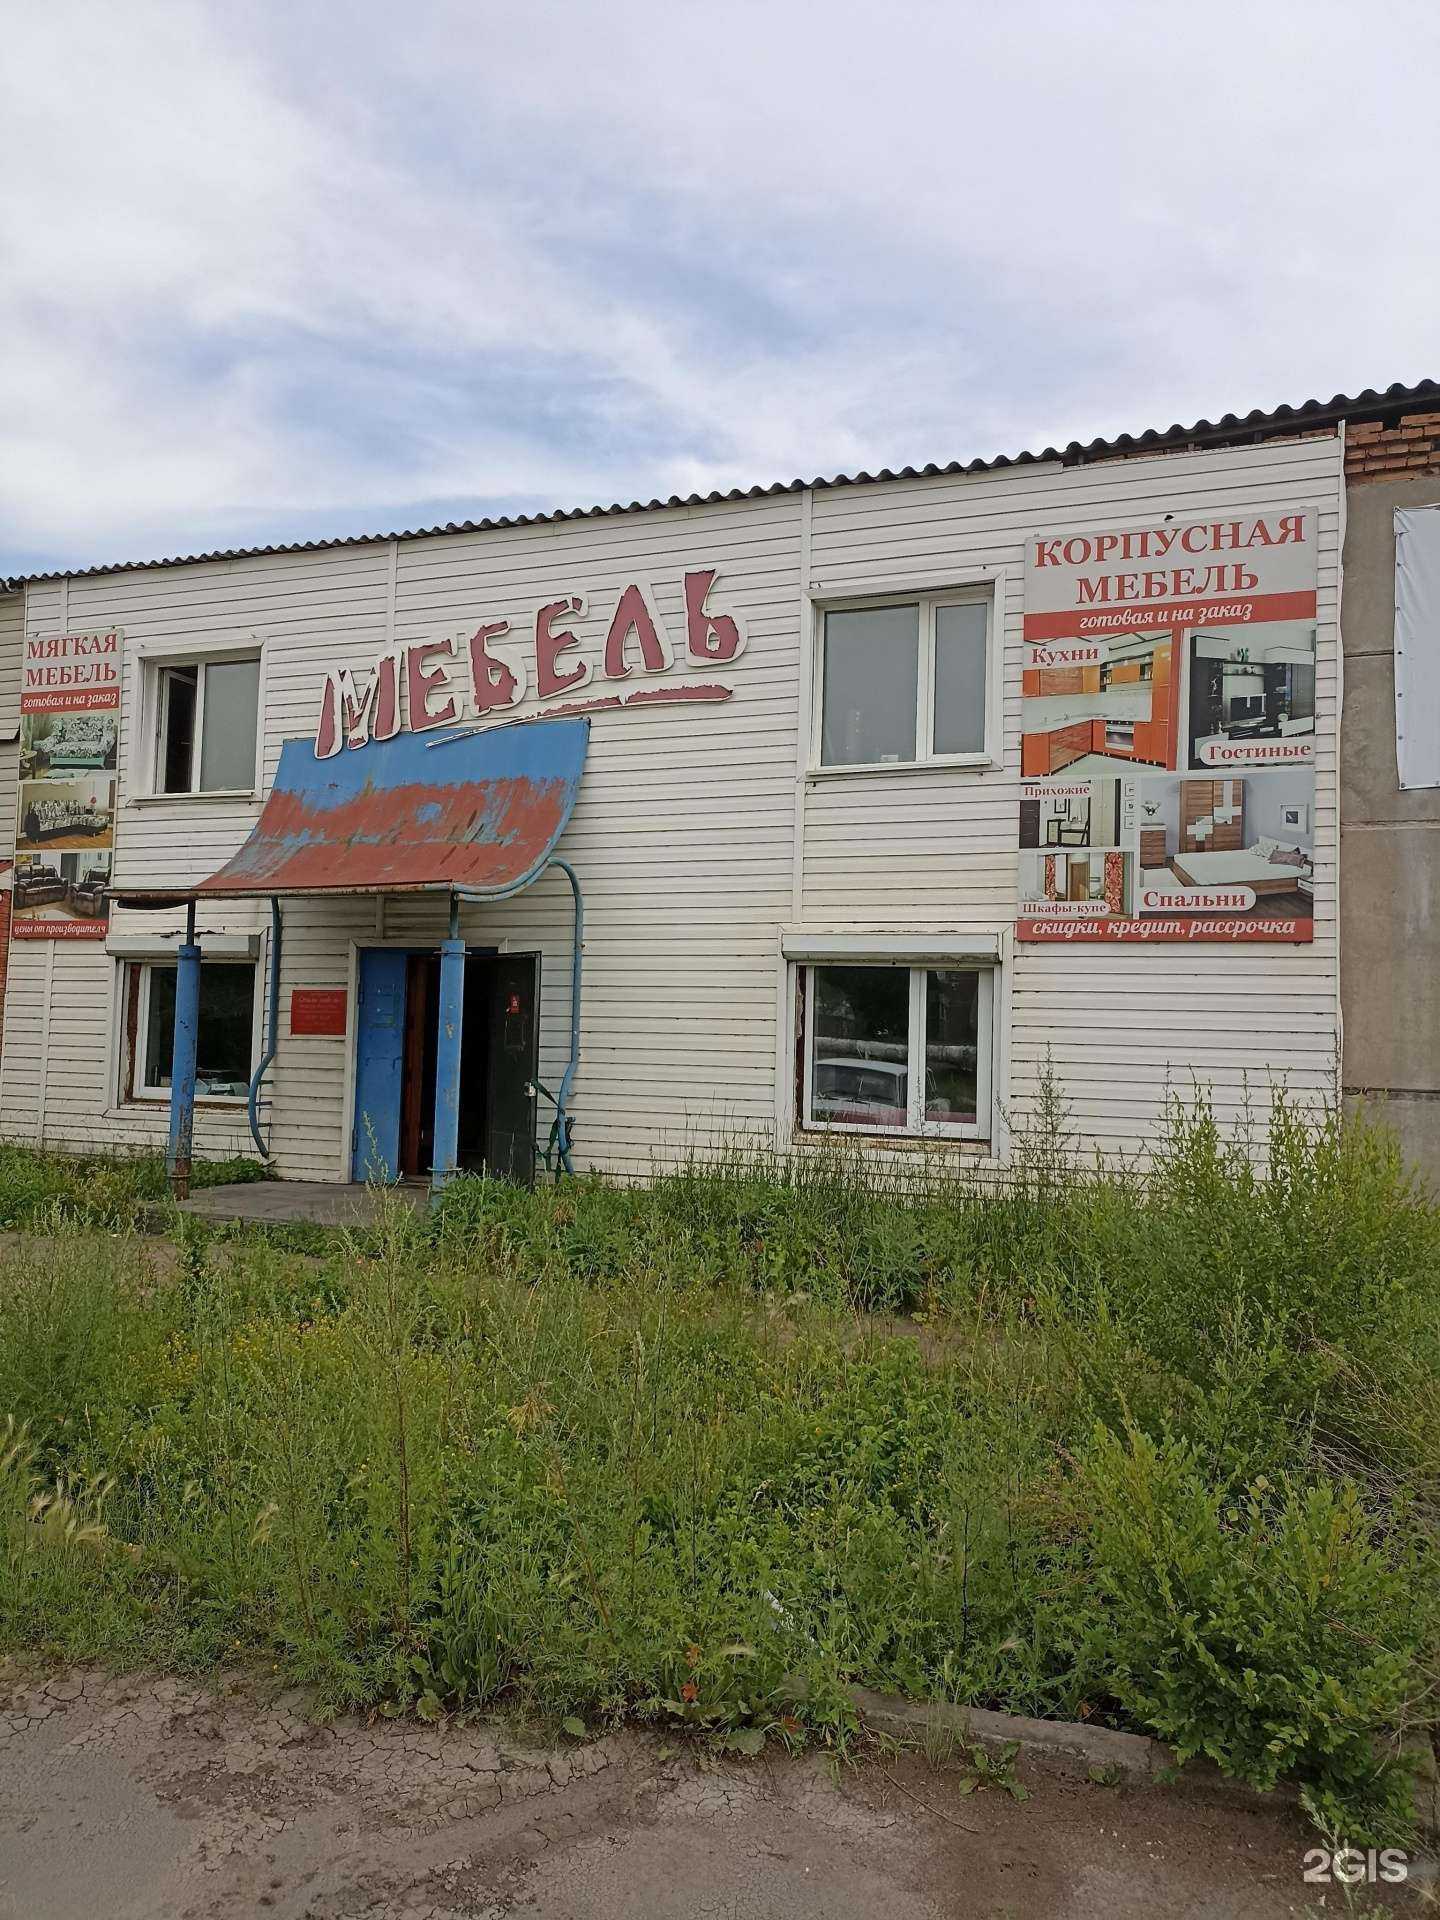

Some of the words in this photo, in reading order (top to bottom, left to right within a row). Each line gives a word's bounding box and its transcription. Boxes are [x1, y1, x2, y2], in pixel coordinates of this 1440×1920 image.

[1035, 515, 1306, 568] КОРПУСНАЯ
[1076, 563, 1259, 604] МЕБЕЛЬ
[1080, 608, 1154, 629] готовая
[1158, 611, 1169, 623] и
[1172, 608, 1194, 622] на
[1199, 602, 1253, 624] заказ
[27, 633, 117, 660] МЯГКАЯ
[314, 568, 748, 760] МЕБЕЛЬ
[1031, 648, 1099, 667] Кухни
[26, 662, 117, 687] МЕБЕЛЬ
[23, 694, 63, 708] готовая
[65, 696, 72, 705] и
[73, 694, 86, 704] на
[87, 692, 117, 708] заказ
[1209, 744, 1312, 761] Гостиные
[1024, 785, 1091, 797] Прихожие
[1143, 891, 1247, 909] Спальни
[1023, 903, 1107, 917] Шкафы-купе
[14, 925, 33, 934] цены
[34, 924, 45, 933] от
[46, 922, 106, 936] производителя
[1032, 919, 1102, 935] скидки,
[1107, 919, 1185, 938] кредит,
[1189, 920, 1296, 937] рассрочка
